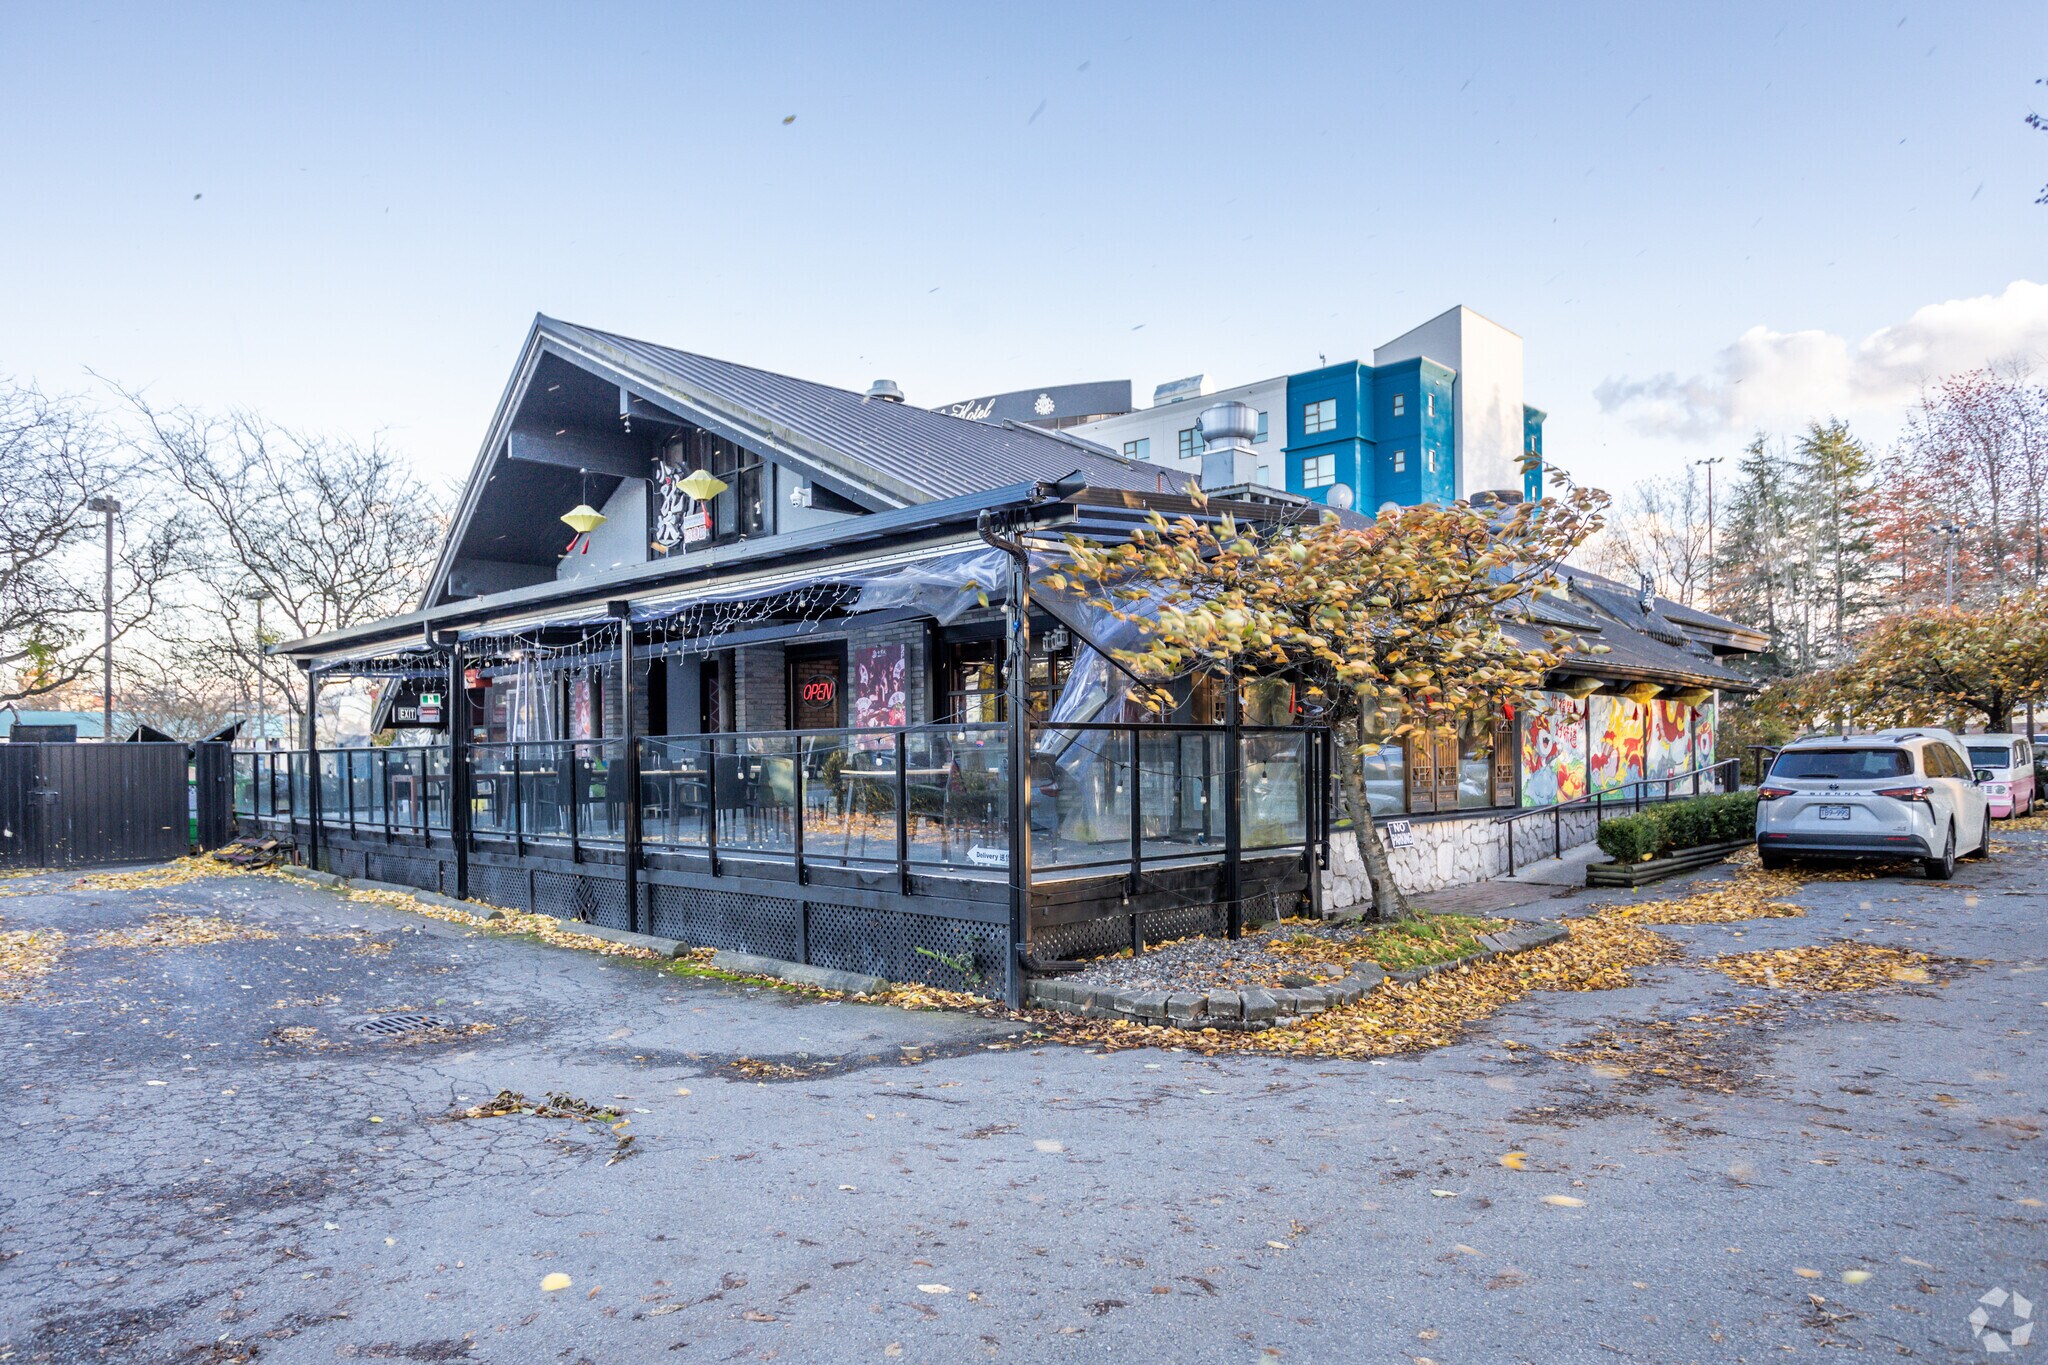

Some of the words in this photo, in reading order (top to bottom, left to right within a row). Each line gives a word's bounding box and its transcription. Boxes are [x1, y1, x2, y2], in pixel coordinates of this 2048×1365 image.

[949, 397, 996, 421] Hotel
[803, 682, 834, 701] OPEN
[400, 709, 416, 719] EXIT
[1393, 822, 1406, 833] NO
[976, 851, 998, 861] Delivery
